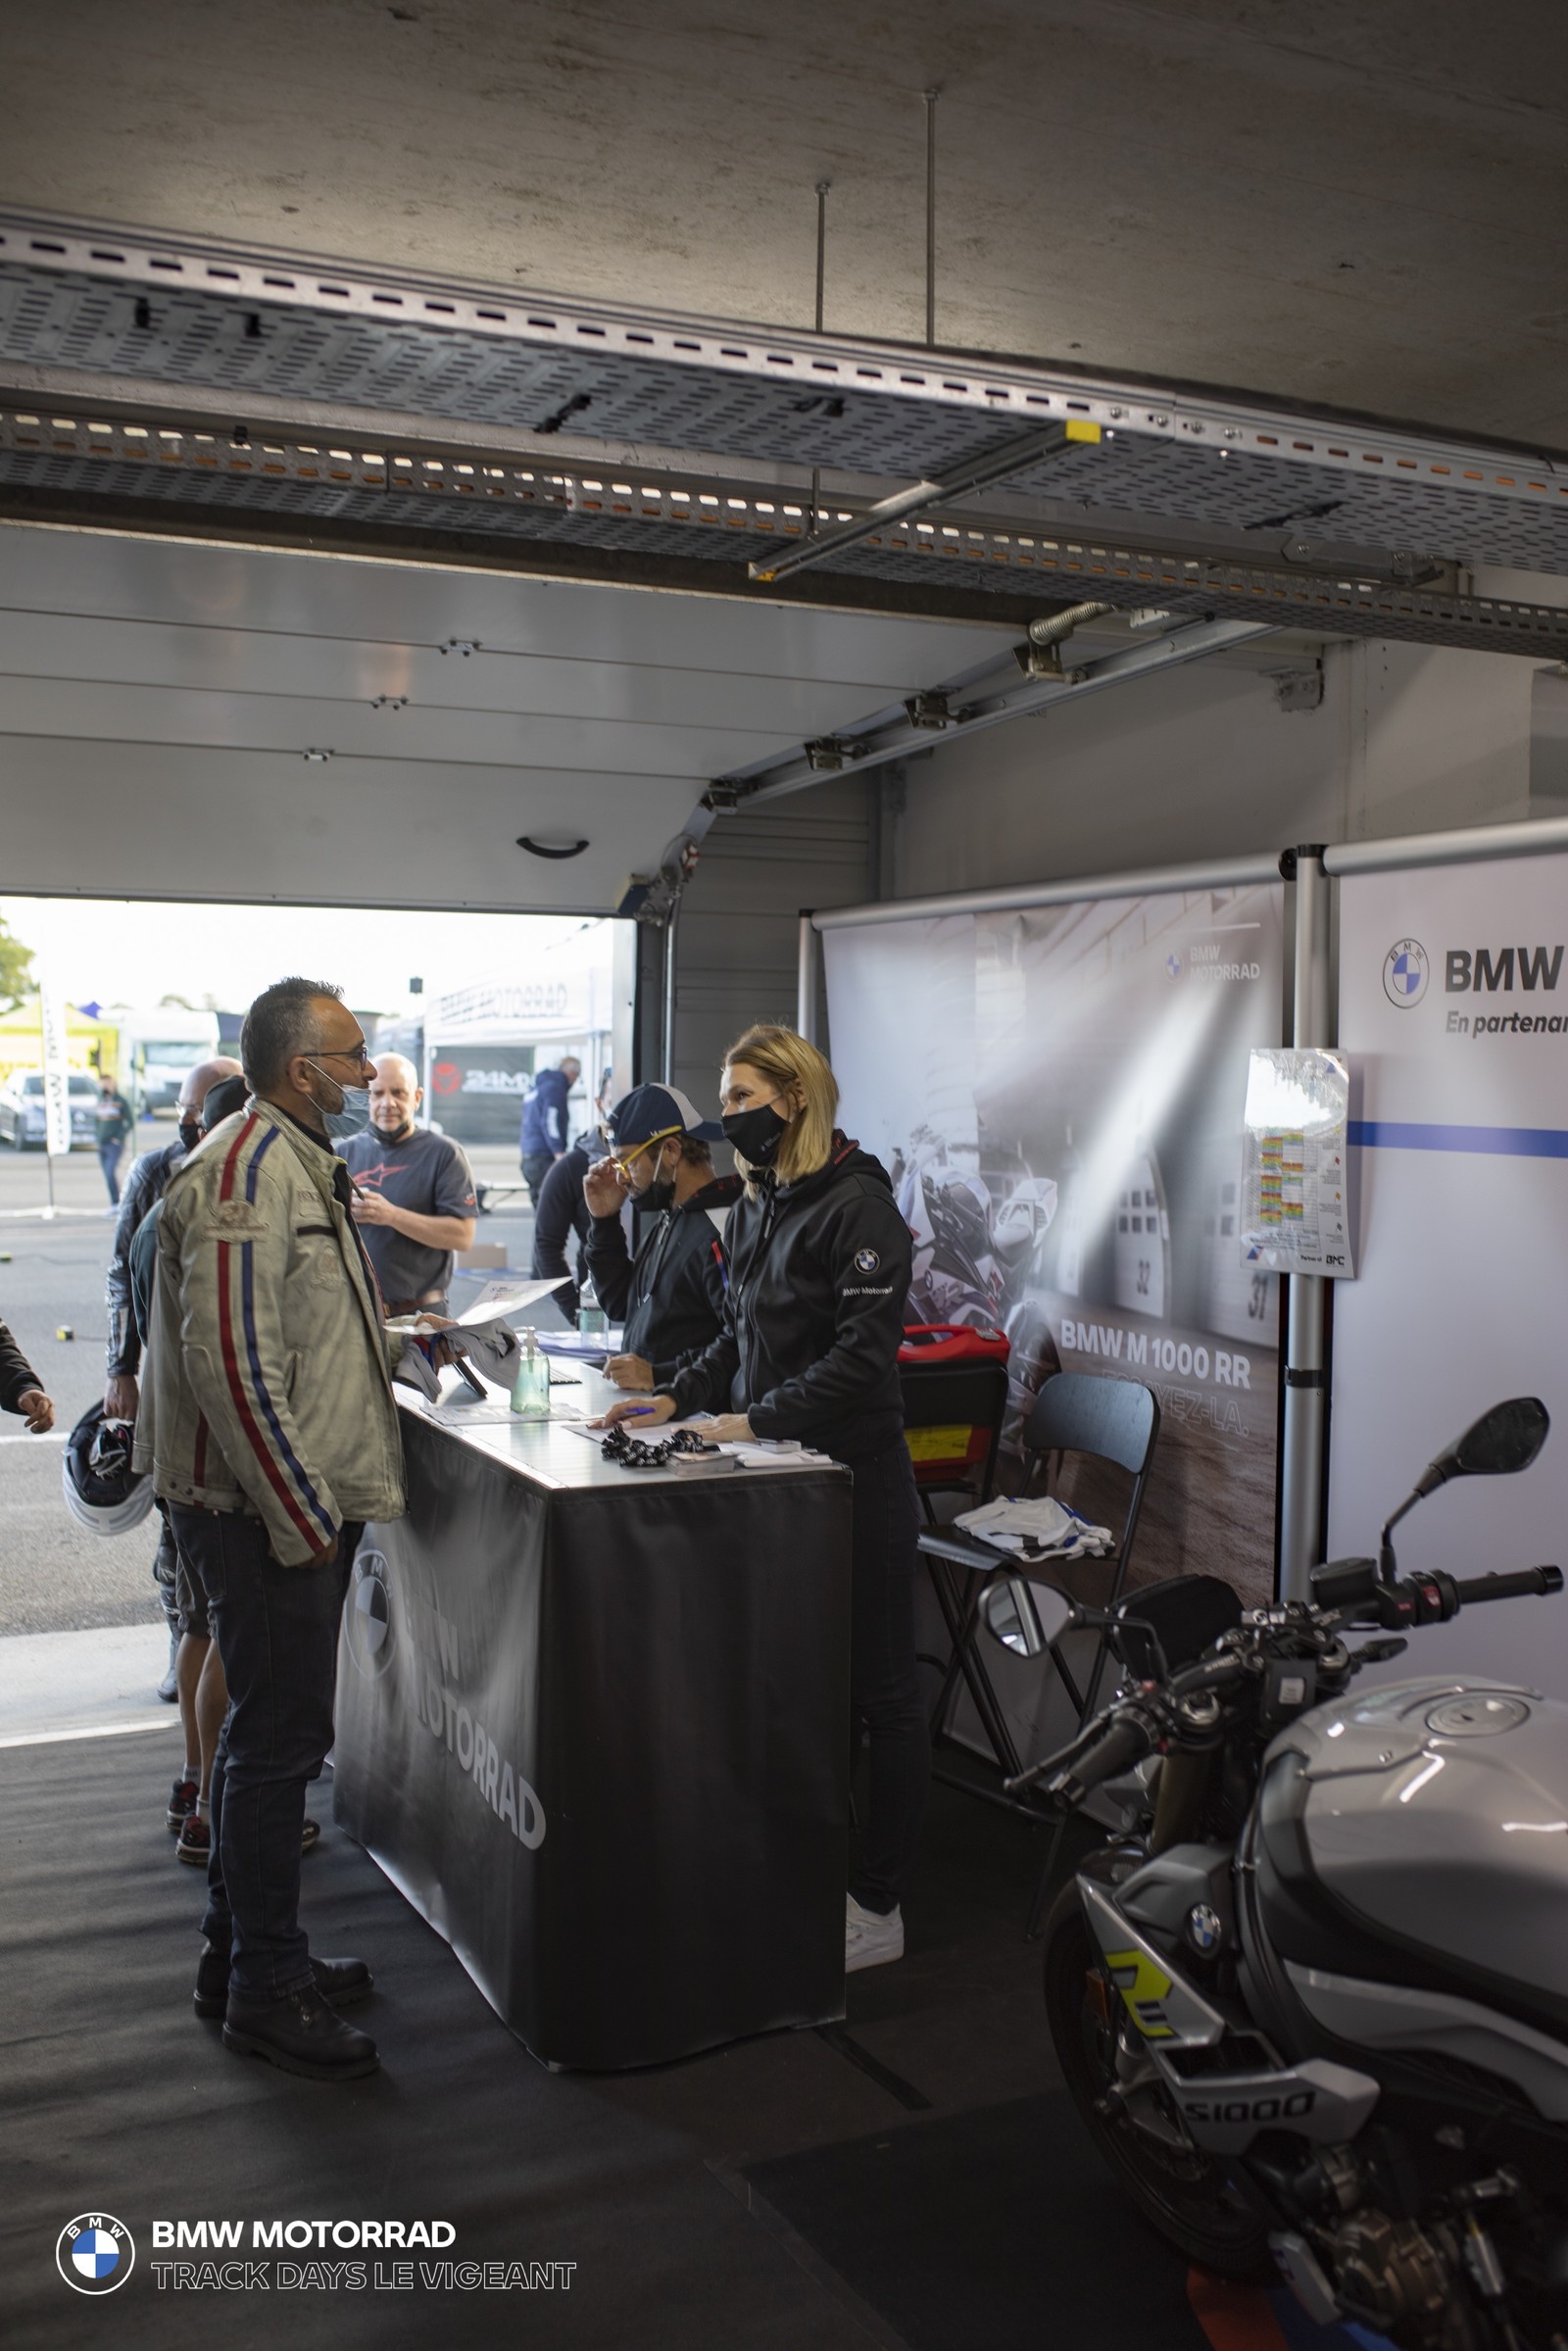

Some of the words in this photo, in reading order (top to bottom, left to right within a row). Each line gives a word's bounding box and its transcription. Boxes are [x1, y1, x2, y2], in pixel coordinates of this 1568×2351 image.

[1190, 945, 1221, 962] BMW
[1190, 962, 1261, 981] MOTORRAD
[1446, 946, 1565, 993] BMW
[1446, 1010, 1470, 1034] En
[861, 1285, 893, 1295] Motorrad
[1248, 1274, 1269, 1321] 31
[1061, 1319, 1123, 1359] BMW
[1128, 1332, 1148, 1365] M
[1152, 1338, 1209, 1380] 1000
[1215, 1350, 1250, 1390] RR
